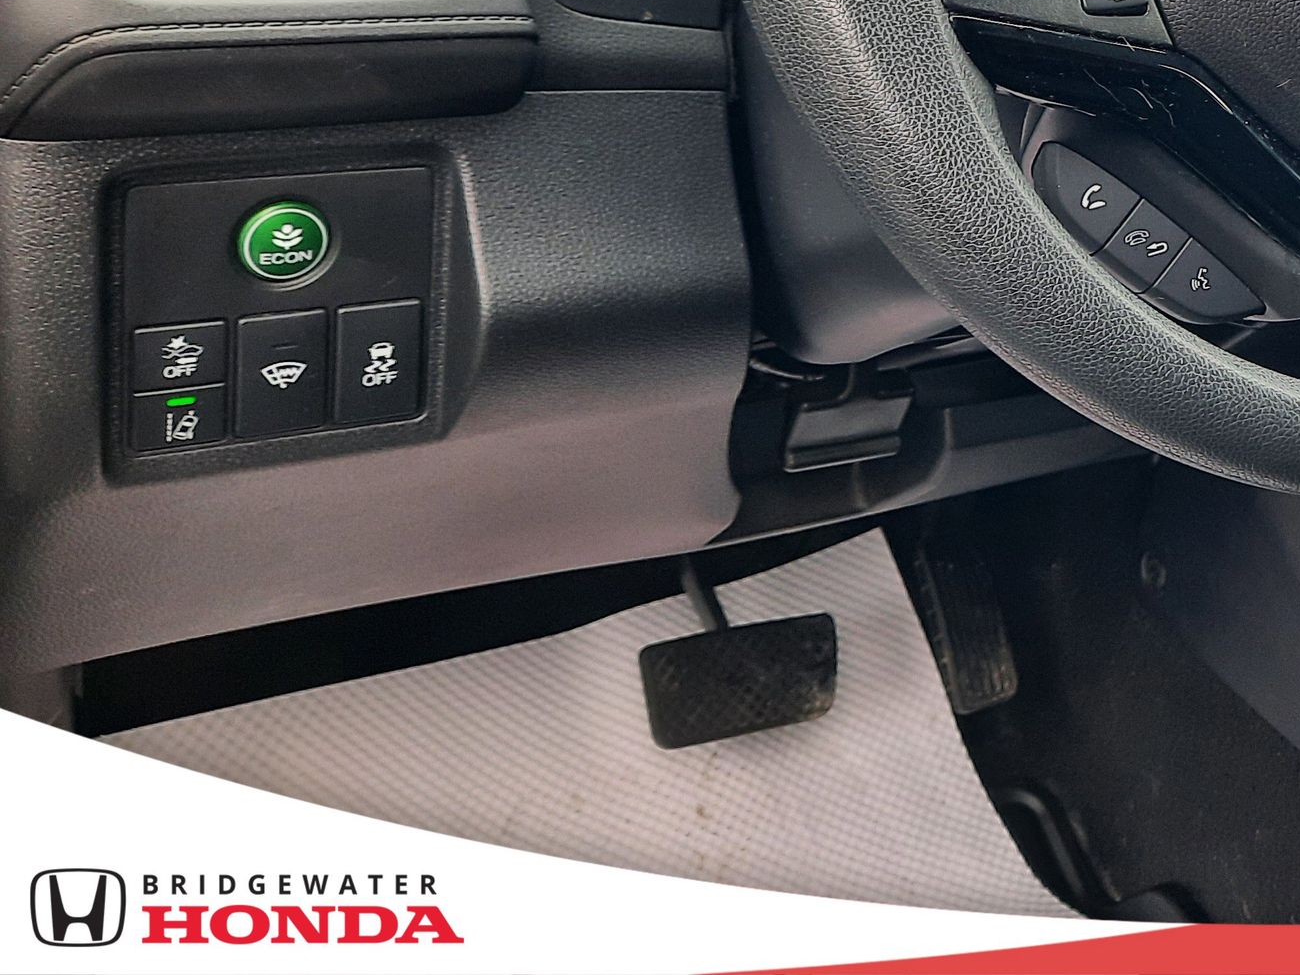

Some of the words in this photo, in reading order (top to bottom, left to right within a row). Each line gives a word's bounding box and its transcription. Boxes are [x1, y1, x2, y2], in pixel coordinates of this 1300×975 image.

[259, 249, 313, 266] ECON
[162, 365, 198, 380] OFF
[361, 370, 398, 388] OFF
